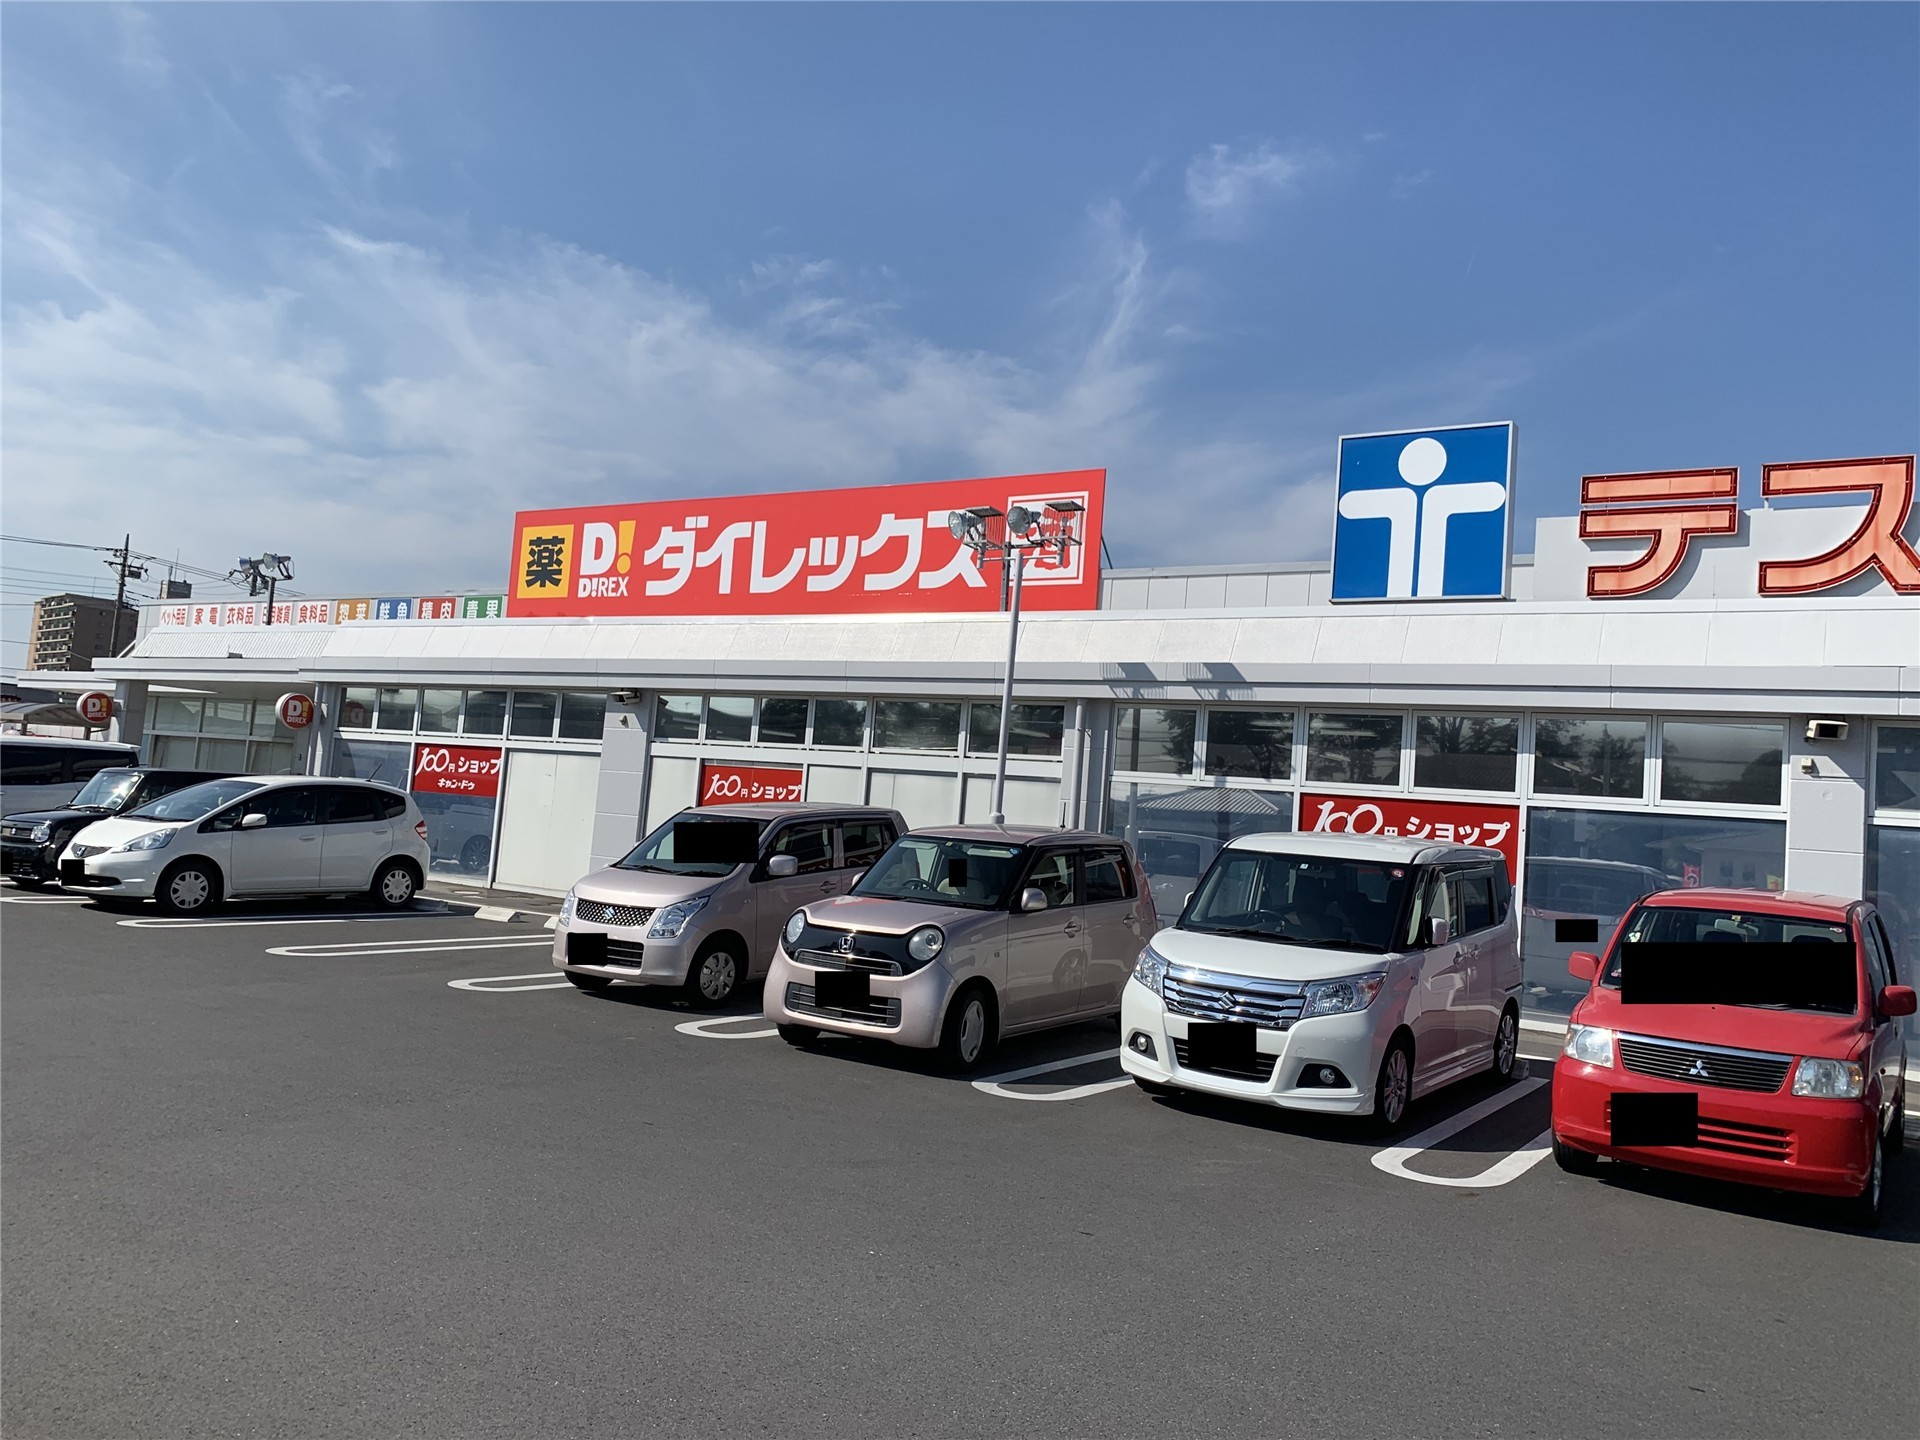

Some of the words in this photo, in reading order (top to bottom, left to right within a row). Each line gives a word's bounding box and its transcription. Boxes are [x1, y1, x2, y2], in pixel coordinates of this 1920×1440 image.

[1579, 454, 1920, 597] テス
[525, 535, 566, 588] 薬
[643, 507, 988, 597] ダイレックス
[161, 608, 186, 625] ペット用品
[194, 607, 219, 625] 家電
[226, 606, 254, 624] 衣料品
[298, 604, 328, 624] 食料品
[379, 602, 408, 620] 鮮魚
[421, 601, 452, 620] 精肉
[466, 600, 499, 619] 青果
